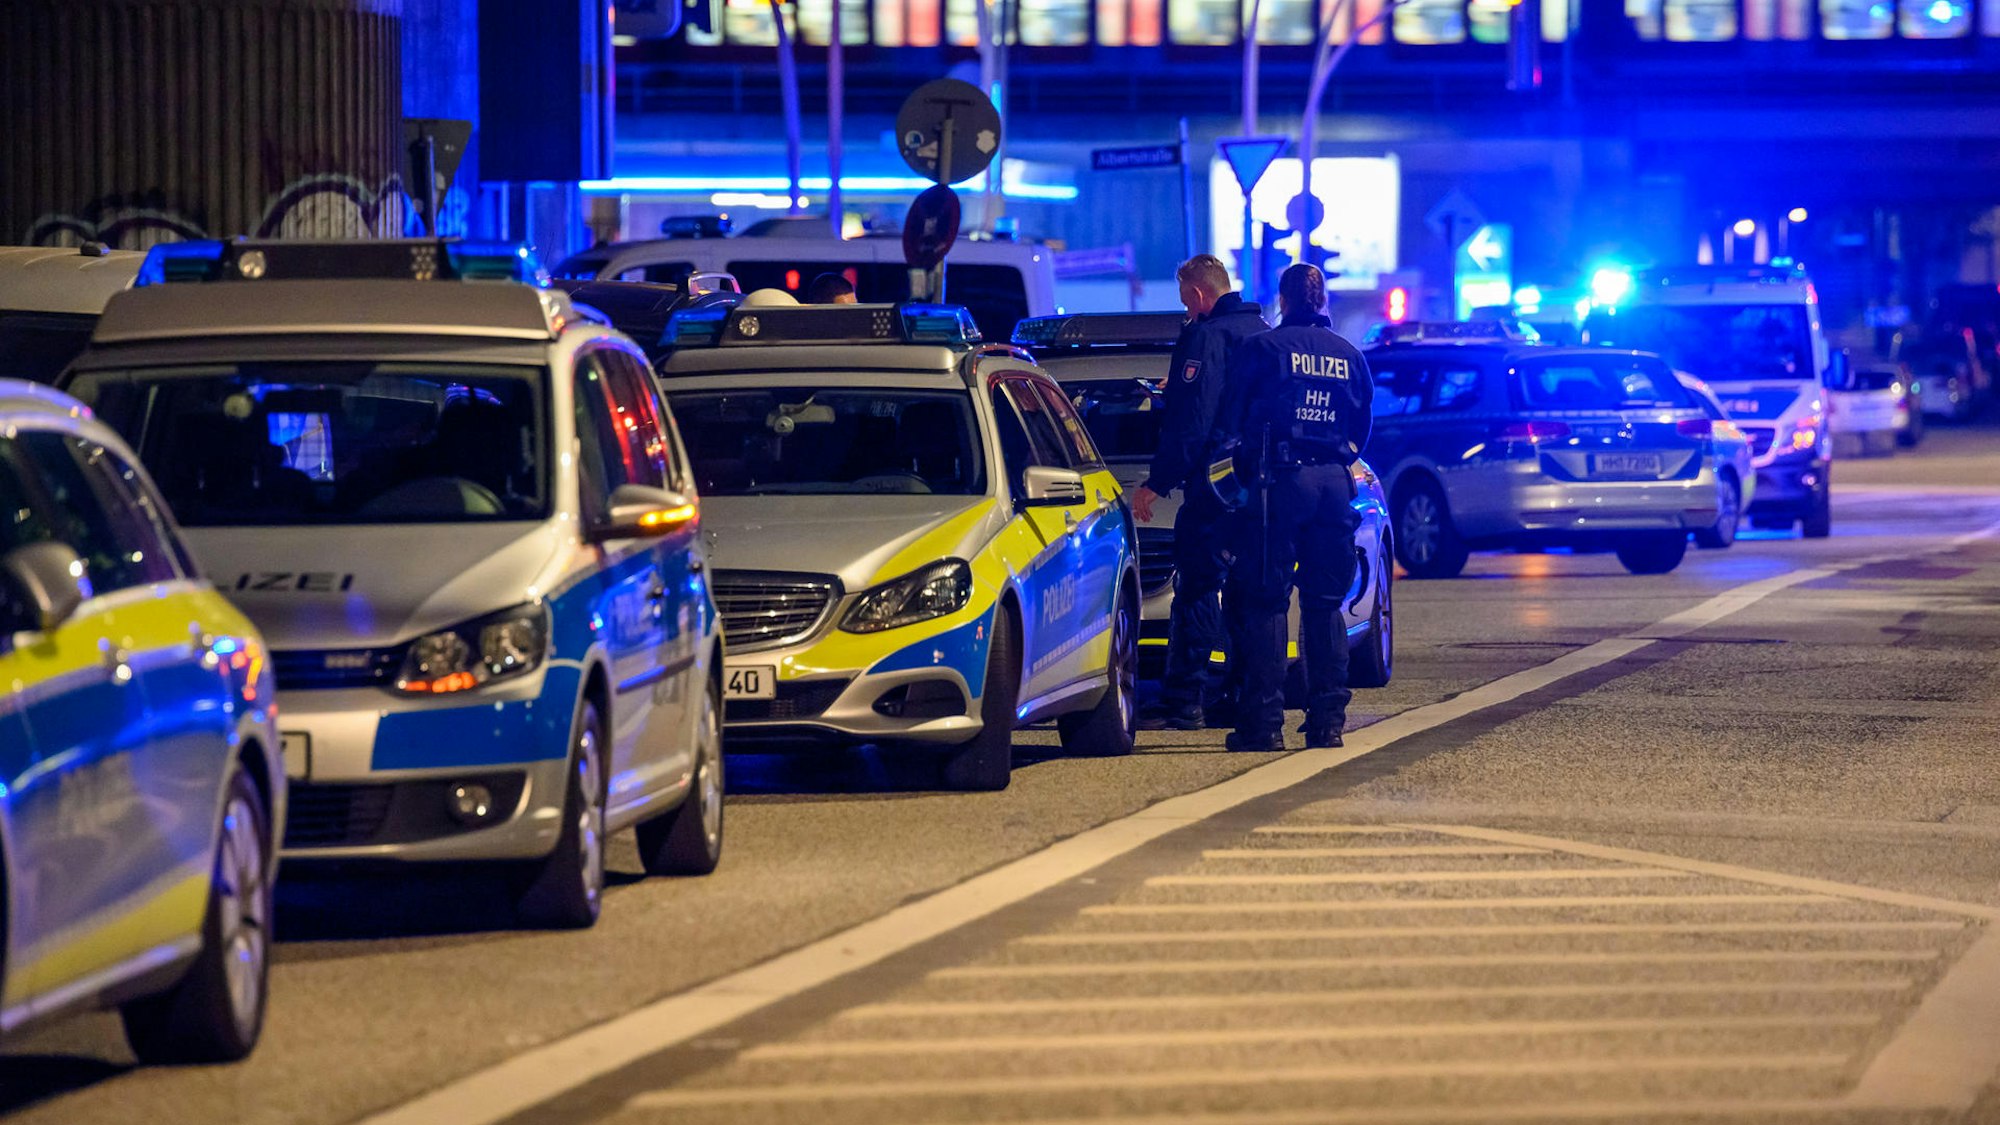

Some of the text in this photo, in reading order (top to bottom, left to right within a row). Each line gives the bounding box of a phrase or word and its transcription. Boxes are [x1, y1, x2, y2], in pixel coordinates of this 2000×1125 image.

[1291, 352, 1349, 380] POLIZEI
[1305, 389, 1331, 407] HH
[1295, 407, 1336, 422] 132214
[1042, 572, 1075, 628] POLIZEI
[725, 670, 759, 694] 40
